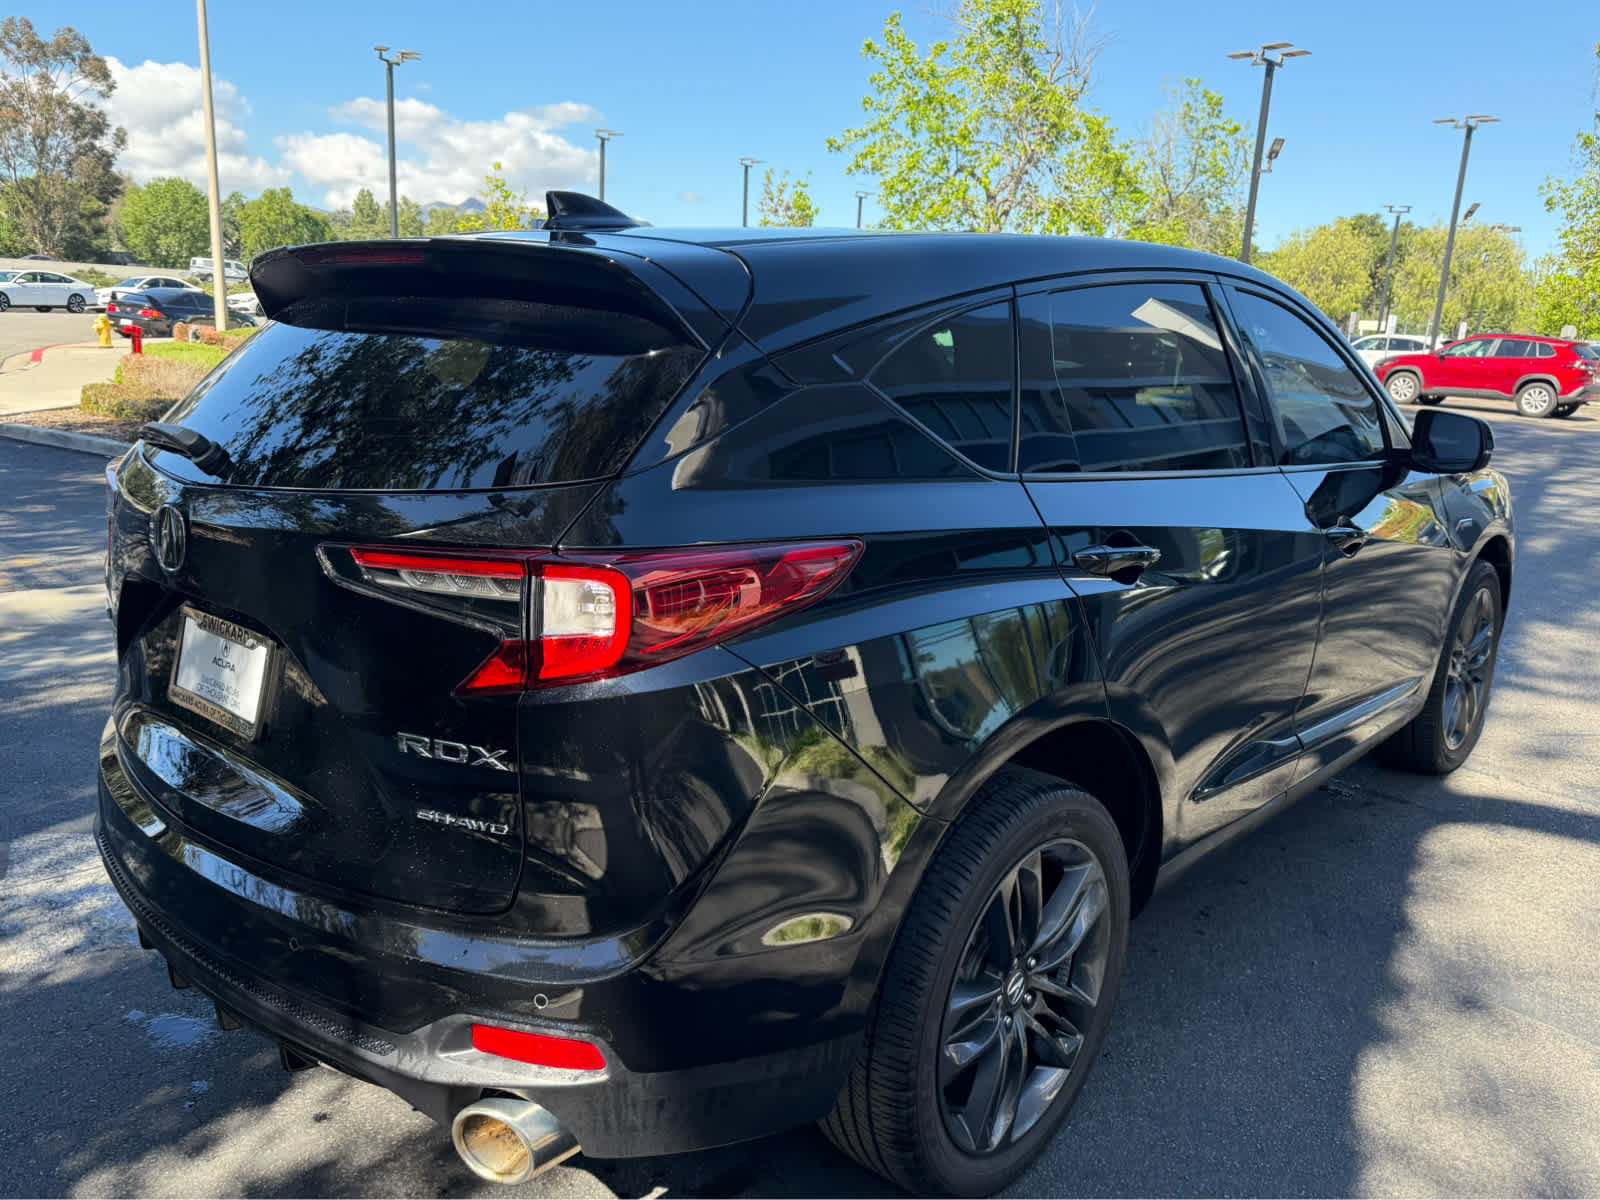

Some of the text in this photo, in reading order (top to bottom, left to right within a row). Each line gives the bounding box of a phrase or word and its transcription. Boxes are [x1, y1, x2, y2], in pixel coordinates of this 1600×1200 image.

[200, 615, 250, 643] SWICKARD
[212, 656, 236, 672] ACURA
[397, 732, 513, 772] RDX
[416, 809, 509, 835] SH-AWD
